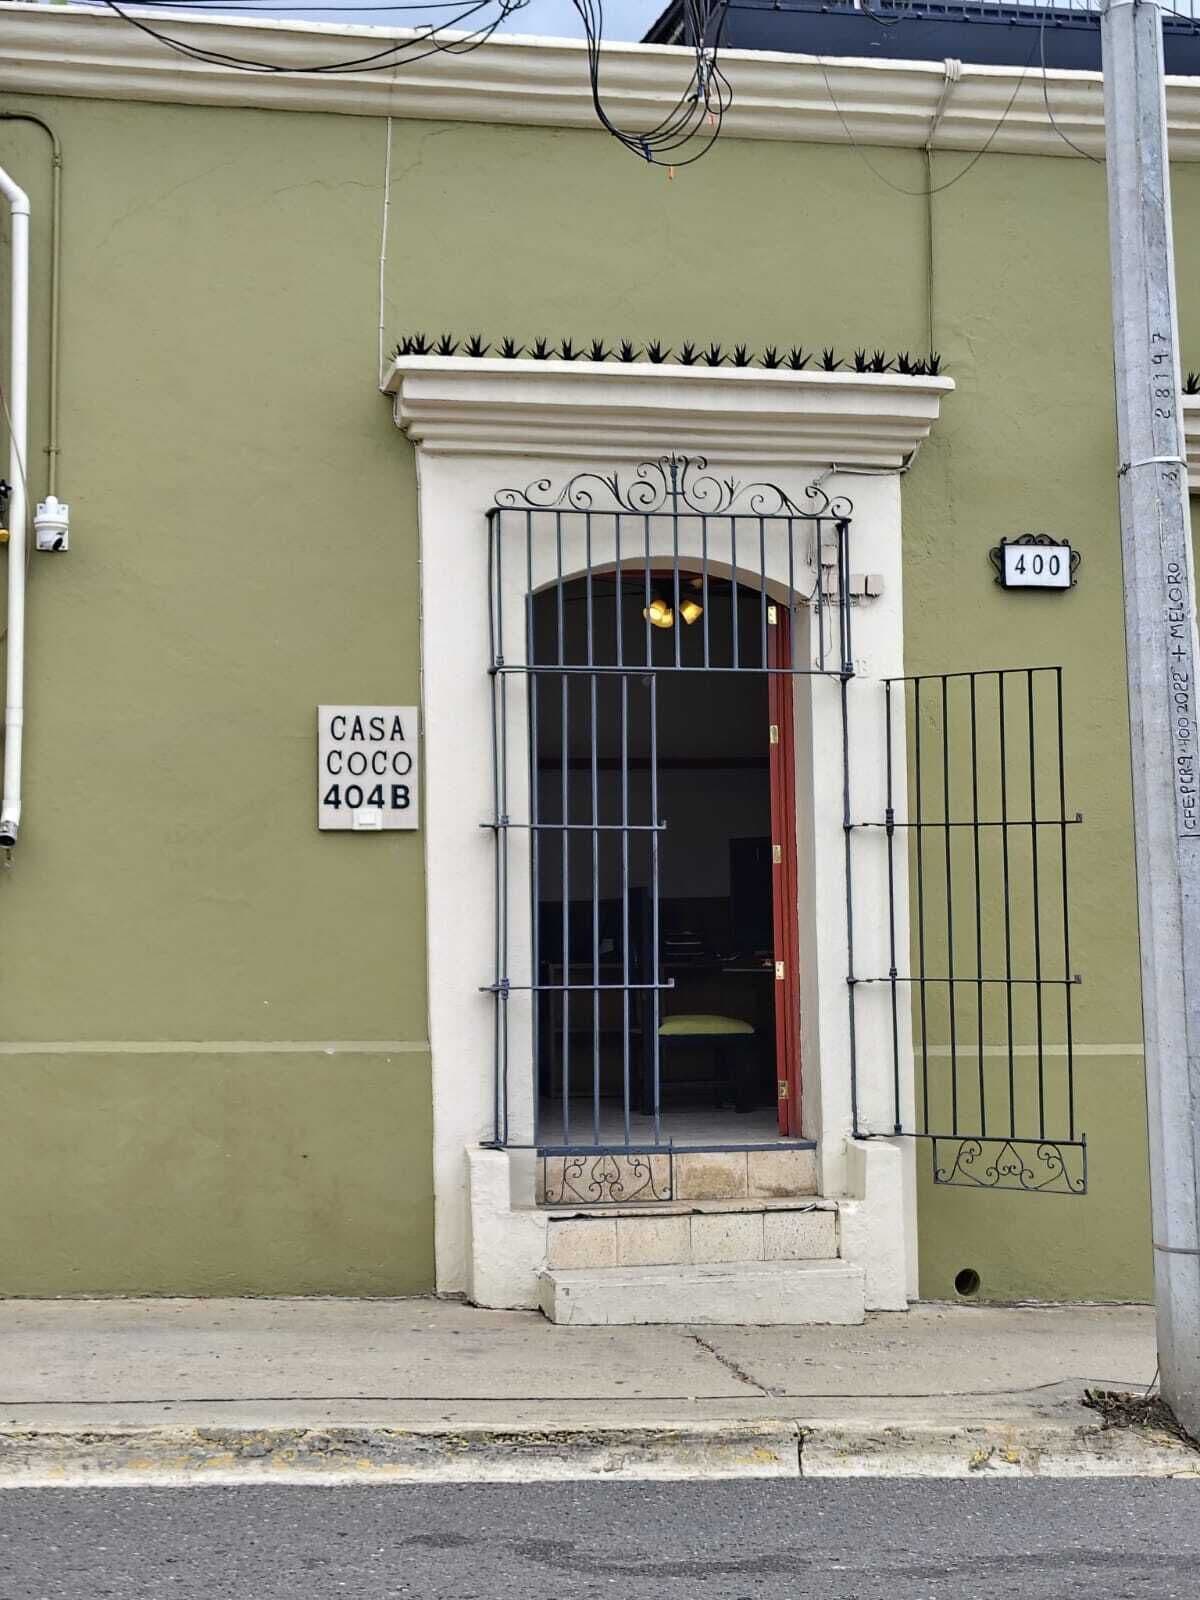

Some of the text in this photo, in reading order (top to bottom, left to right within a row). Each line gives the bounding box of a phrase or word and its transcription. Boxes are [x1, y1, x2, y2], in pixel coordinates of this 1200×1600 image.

[1014, 553, 1060, 575] 400
[1173, 672, 1189, 713] 2022
[330, 715, 405, 741] CASA
[326, 750, 412, 776] COCO
[323, 783, 410, 809] 404B
